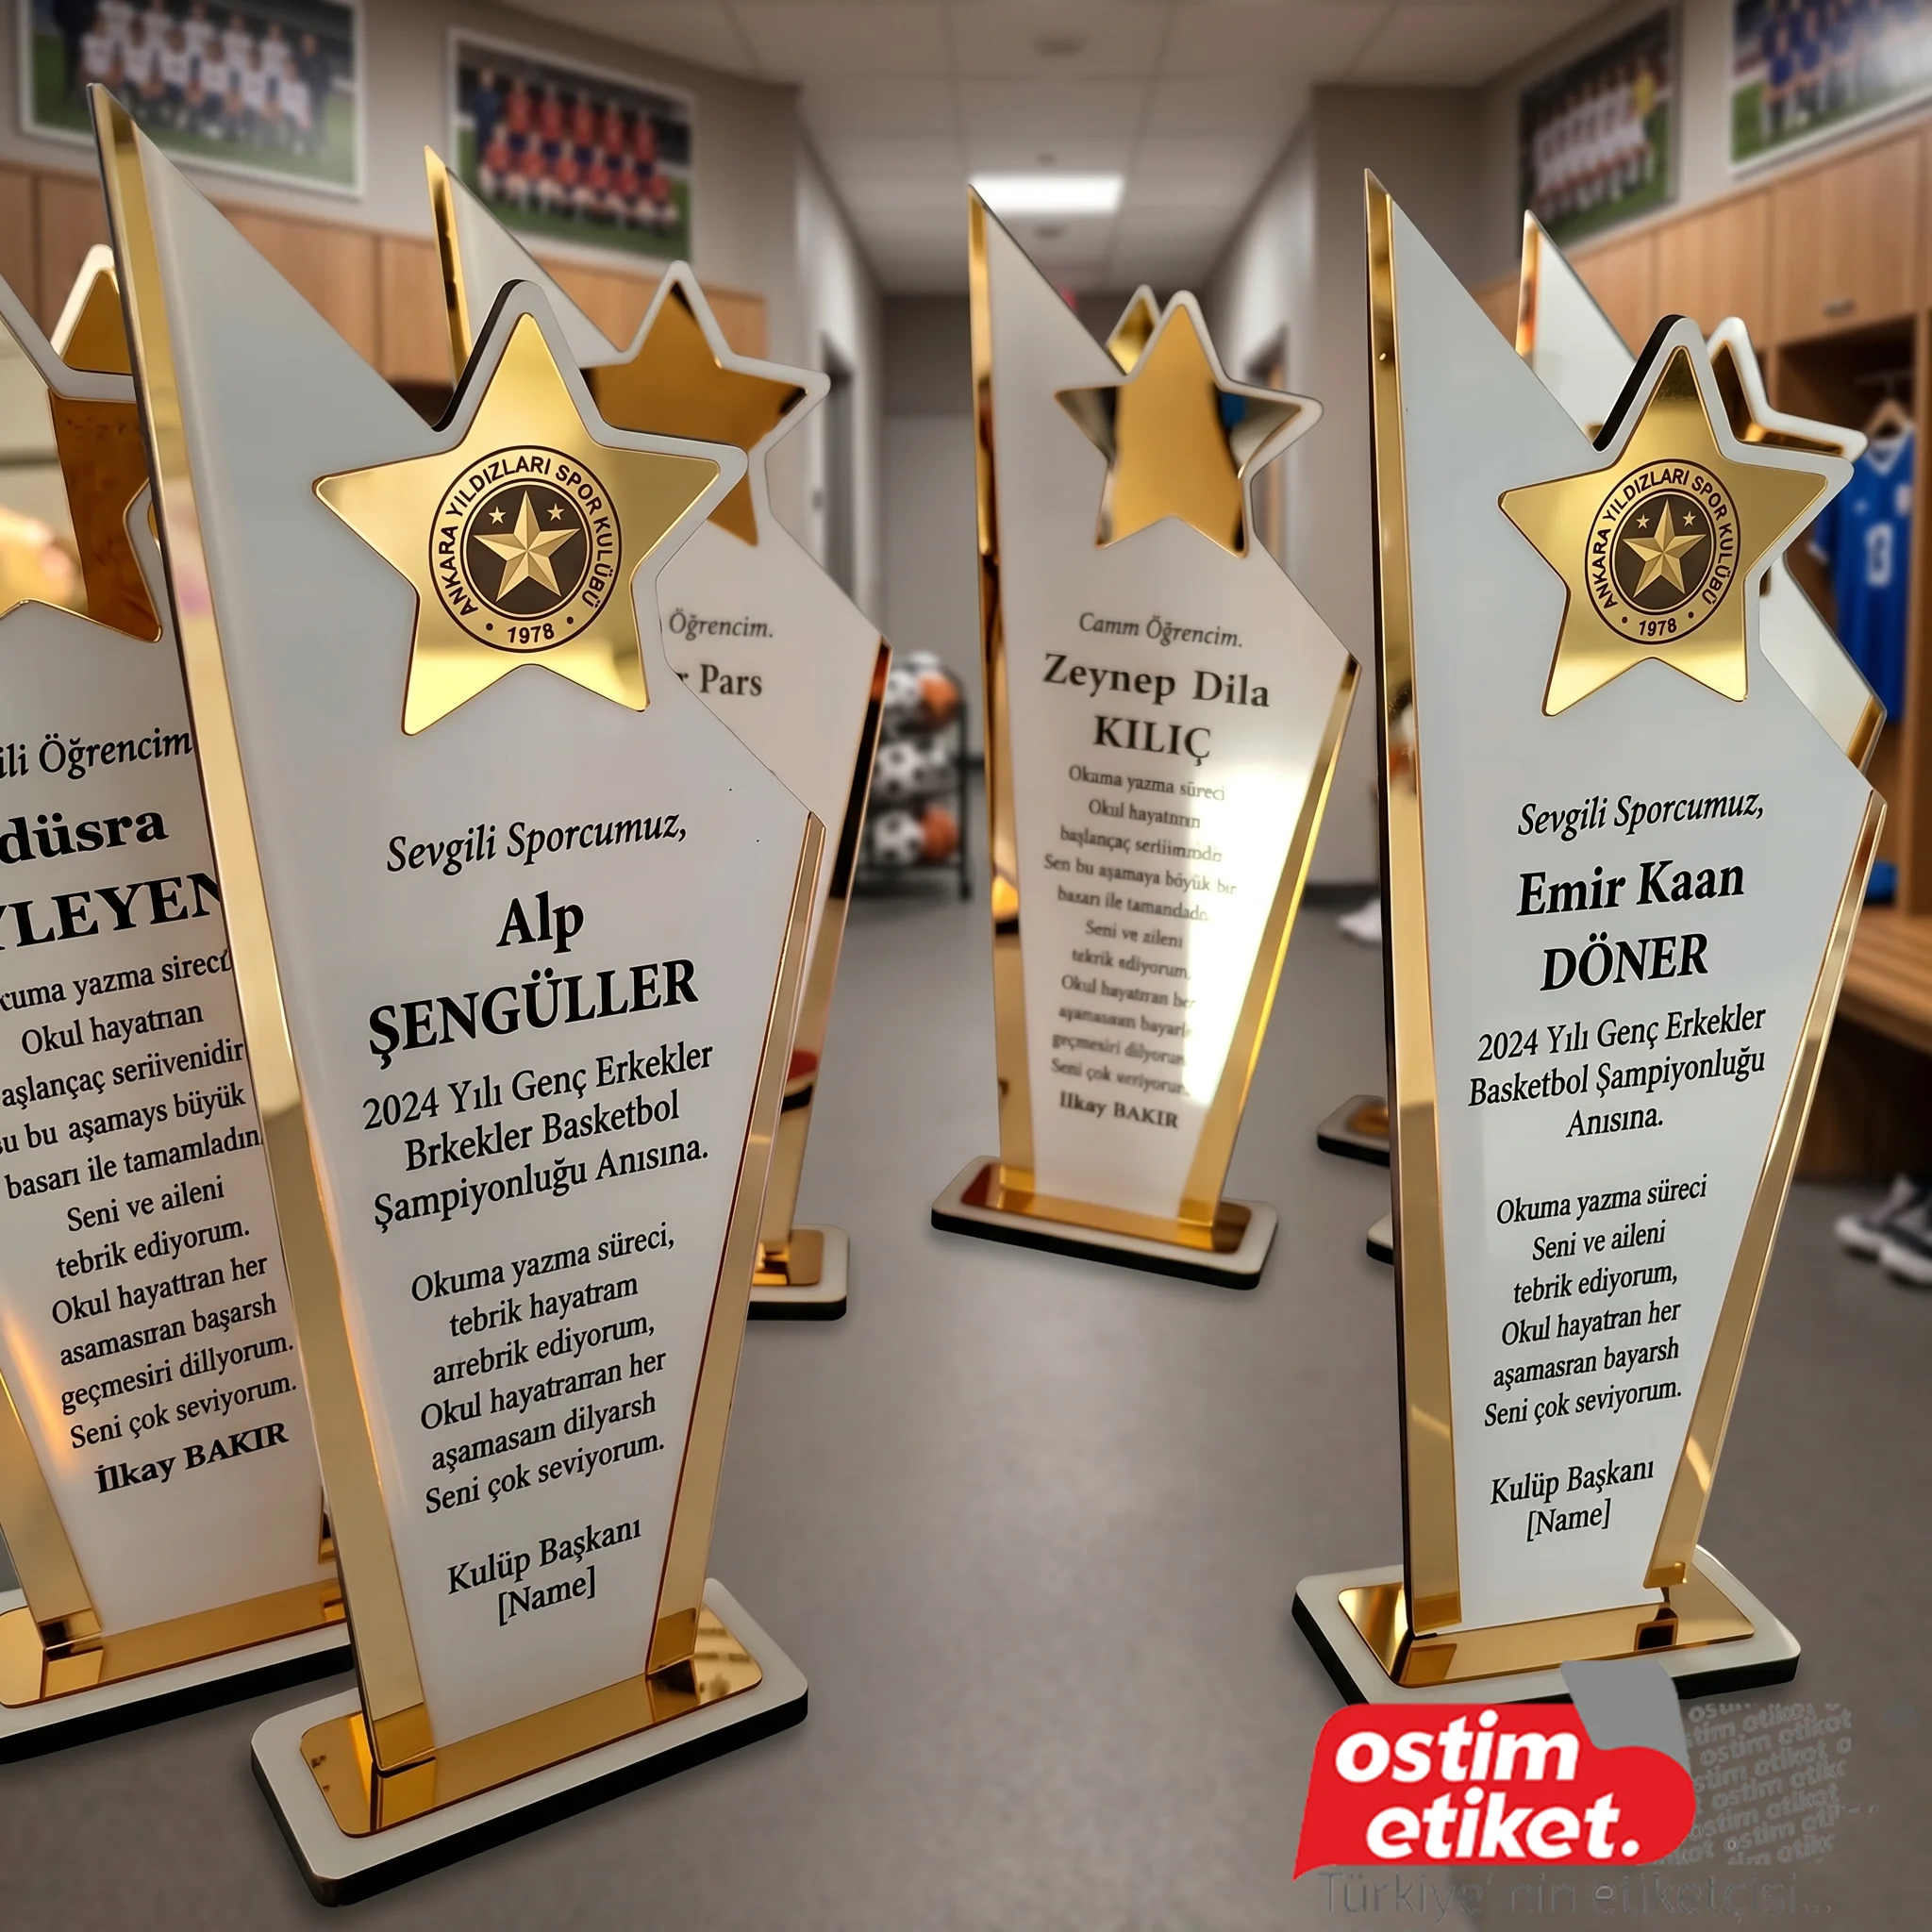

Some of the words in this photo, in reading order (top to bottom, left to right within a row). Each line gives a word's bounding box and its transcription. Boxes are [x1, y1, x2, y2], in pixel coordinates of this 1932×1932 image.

[445, 456, 552, 517] YILDIZLARI
[555, 464, 603, 516] SPOR
[1603, 468, 1690, 522] YILDIZLARI
[1691, 475, 1728, 522] SPOR
[439, 525, 478, 616] ANKARA
[581, 516, 614, 608] KULÜBÜ
[1591, 528, 1619, 609] ANKARA
[1701, 522, 1734, 606] KULÜBÜ
[507, 622, 555, 644] 1978
[669, 608, 774, 641] Öğrencim.
[1145, 614, 1243, 648] Öğrencim.
[1639, 617, 1677, 637] 1978
[699, 663, 763, 697] Pars
[1041, 652, 1176, 706] Zeynep
[1191, 670, 1271, 708] Dila
[39, 727, 193, 780] Öğrencim
[1092, 714, 1211, 767] KILIÇ
[387, 824, 496, 876] Sevgili
[507, 813, 687, 866] Sporcumuz,
[1517, 795, 1608, 842] Sevgili
[1613, 793, 1764, 836] Sporcumuz,
[0, 872, 223, 951] LEYEN
[1515, 865, 1626, 917] Emir
[1636, 859, 1744, 906] Kaan
[495, 890, 584, 955] Alp
[73, 964, 155, 1007] yazma
[1540, 931, 1708, 991] DÖNER
[21, 1019, 85, 1055] Okul
[368, 958, 699, 1070] ŞENGÜLLER
[1477, 1028, 1539, 1062] 2024
[1546, 1021, 1589, 1055] Yılı
[1597, 1018, 1659, 1050] Genç
[1664, 1002, 1767, 1041] Erkekler
[1, 1070, 106, 1110] aşlançaç
[362, 1086, 440, 1130] 2024
[447, 1074, 503, 1114] Yılı
[511, 1069, 588, 1102] Genç
[595, 1041, 713, 1088] Erkekler
[1467, 1063, 1589, 1107] Basketbol
[1595, 1045, 1765, 1099] Şampiyonluğu
[24, 1122, 58, 1149] bu
[68, 1104, 168, 1143] aşamays
[173, 1081, 246, 1120] büyük
[404, 1121, 533, 1172] Brkekler
[541, 1088, 679, 1145] Basketbol
[1113, 1100, 1178, 1129] BAKIR
[1565, 1108, 1663, 1139] Anısına.
[3, 1167, 81, 1199] basarı
[87, 1154, 118, 1182] ile
[67, 1198, 120, 1232] Seni
[125, 1197, 155, 1218] ve
[161, 1174, 225, 1211] aileni
[375, 1157, 588, 1234] Şampiyonluğu
[594, 1140, 708, 1181] Anısına.
[1496, 1196, 1572, 1224] Okuma
[1575, 1189, 1642, 1222] yazma
[1646, 1173, 1707, 1205] süreci
[55, 1241, 128, 1279] tebrik
[133, 1221, 250, 1261] ediyorum.
[411, 1265, 506, 1306] Okuma
[510, 1246, 591, 1289] yazma
[597, 1221, 675, 1261] süreci,
[1532, 1231, 1576, 1261] Seni
[1582, 1234, 1606, 1254] ve
[1610, 1218, 1666, 1250] aileni
[52, 1288, 112, 1324] Okul
[229, 1257, 268, 1282] her
[1513, 1272, 1574, 1304] tebrik
[1577, 1265, 1677, 1298] ediyorum,
[449, 1297, 523, 1338] tebrik
[536, 1316, 655, 1359] ediyorum,
[1501, 1314, 1551, 1346] Okul
[1647, 1299, 1682, 1324] her
[1604, 1335, 1679, 1374] bayarsh
[61, 1358, 174, 1420] geçmesiri
[70, 1414, 124, 1449] Seni
[128, 1402, 171, 1440] çok
[175, 1376, 297, 1422] seviyorum.
[421, 1391, 482, 1430] Okul
[628, 1352, 667, 1378] her
[563, 1390, 657, 1436] dilyarsh
[1484, 1397, 1528, 1427] Seni
[1534, 1391, 1571, 1426] çok
[1574, 1381, 1682, 1414] seviyorum.
[93, 1457, 176, 1494] İlkay
[182, 1423, 290, 1471] BAKIR
[425, 1475, 481, 1514] Seni
[488, 1463, 532, 1504] çok
[538, 1434, 664, 1484] seviyorum.
[1490, 1472, 1559, 1506] Kulüp
[1566, 1458, 1654, 1494] Başkanı
[1526, 1497, 1611, 1542] [Name]
[447, 1550, 531, 1595] Kulüp
[538, 1519, 641, 1568] Başkanı
[498, 1564, 596, 1627] [Name]
